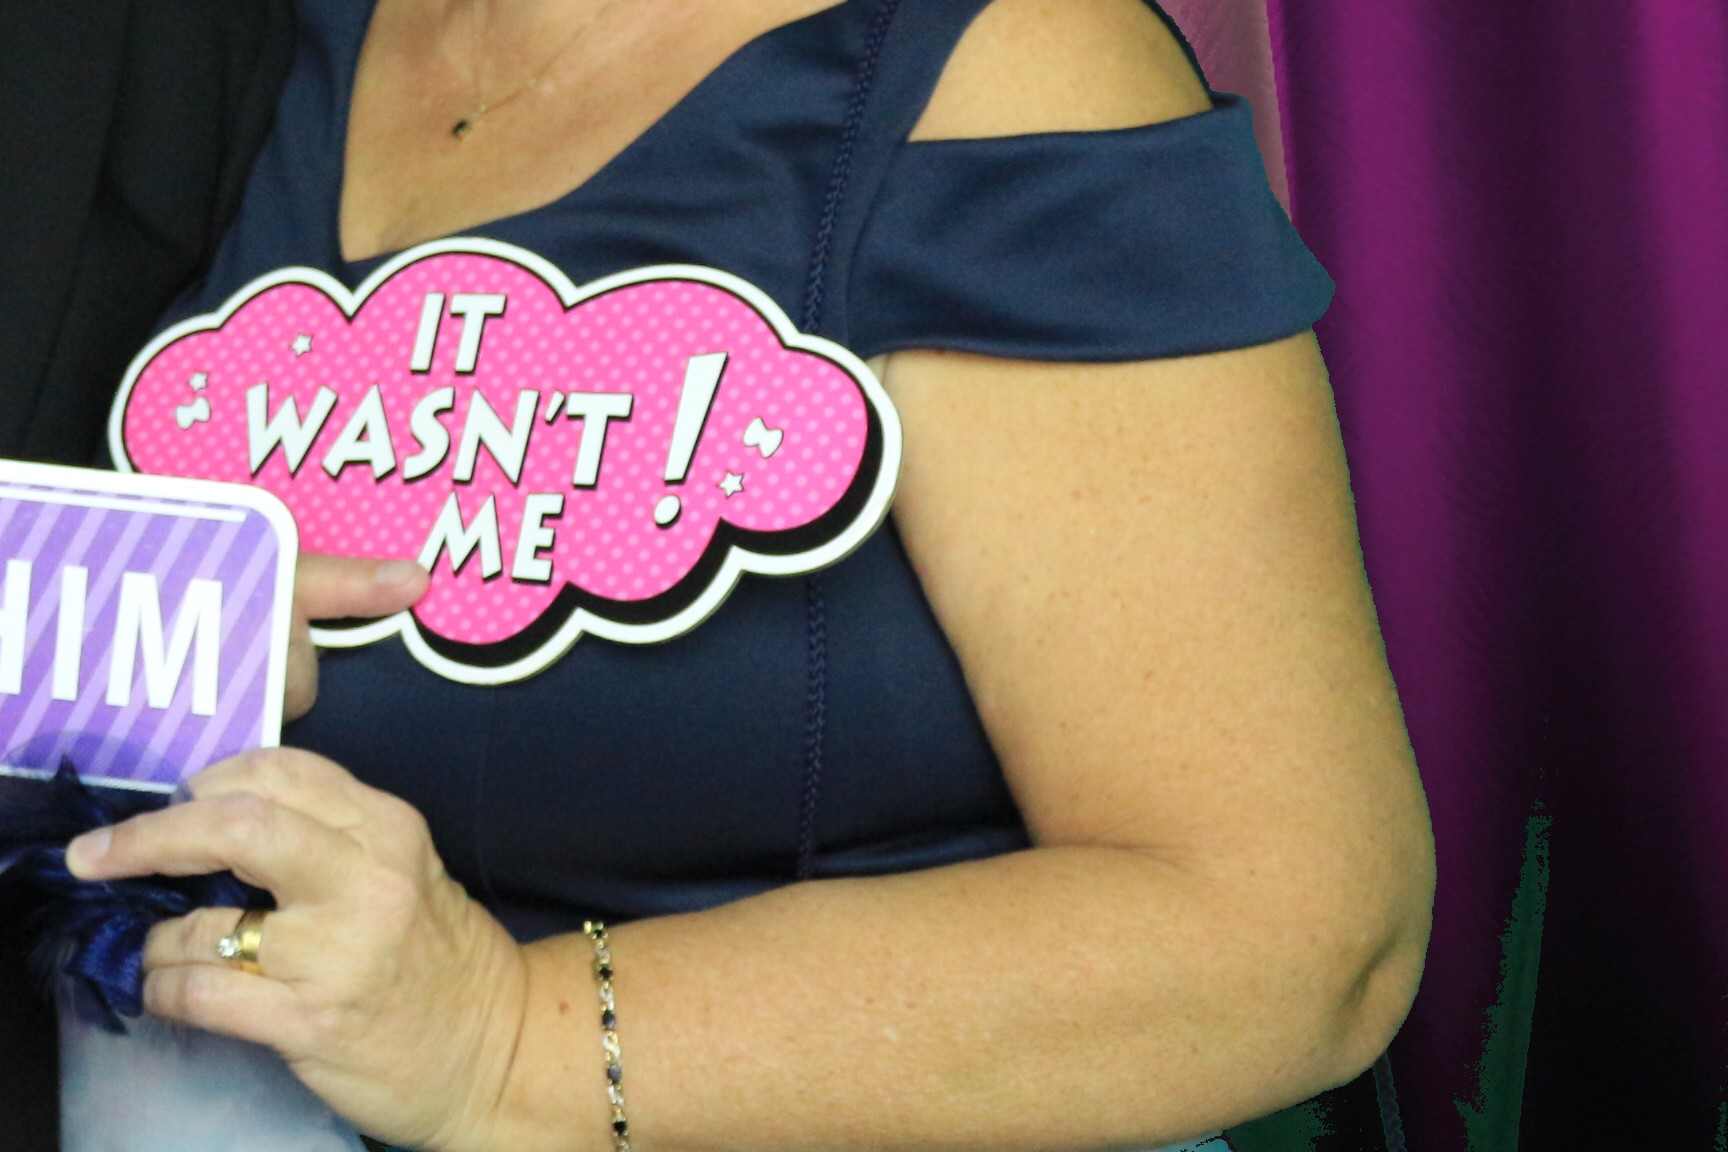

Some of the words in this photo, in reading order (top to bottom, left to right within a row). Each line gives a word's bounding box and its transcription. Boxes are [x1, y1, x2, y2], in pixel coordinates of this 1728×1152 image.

[411, 293, 506, 373] IT
[245, 384, 632, 488] WASN'T
[416, 490, 565, 586] ME
